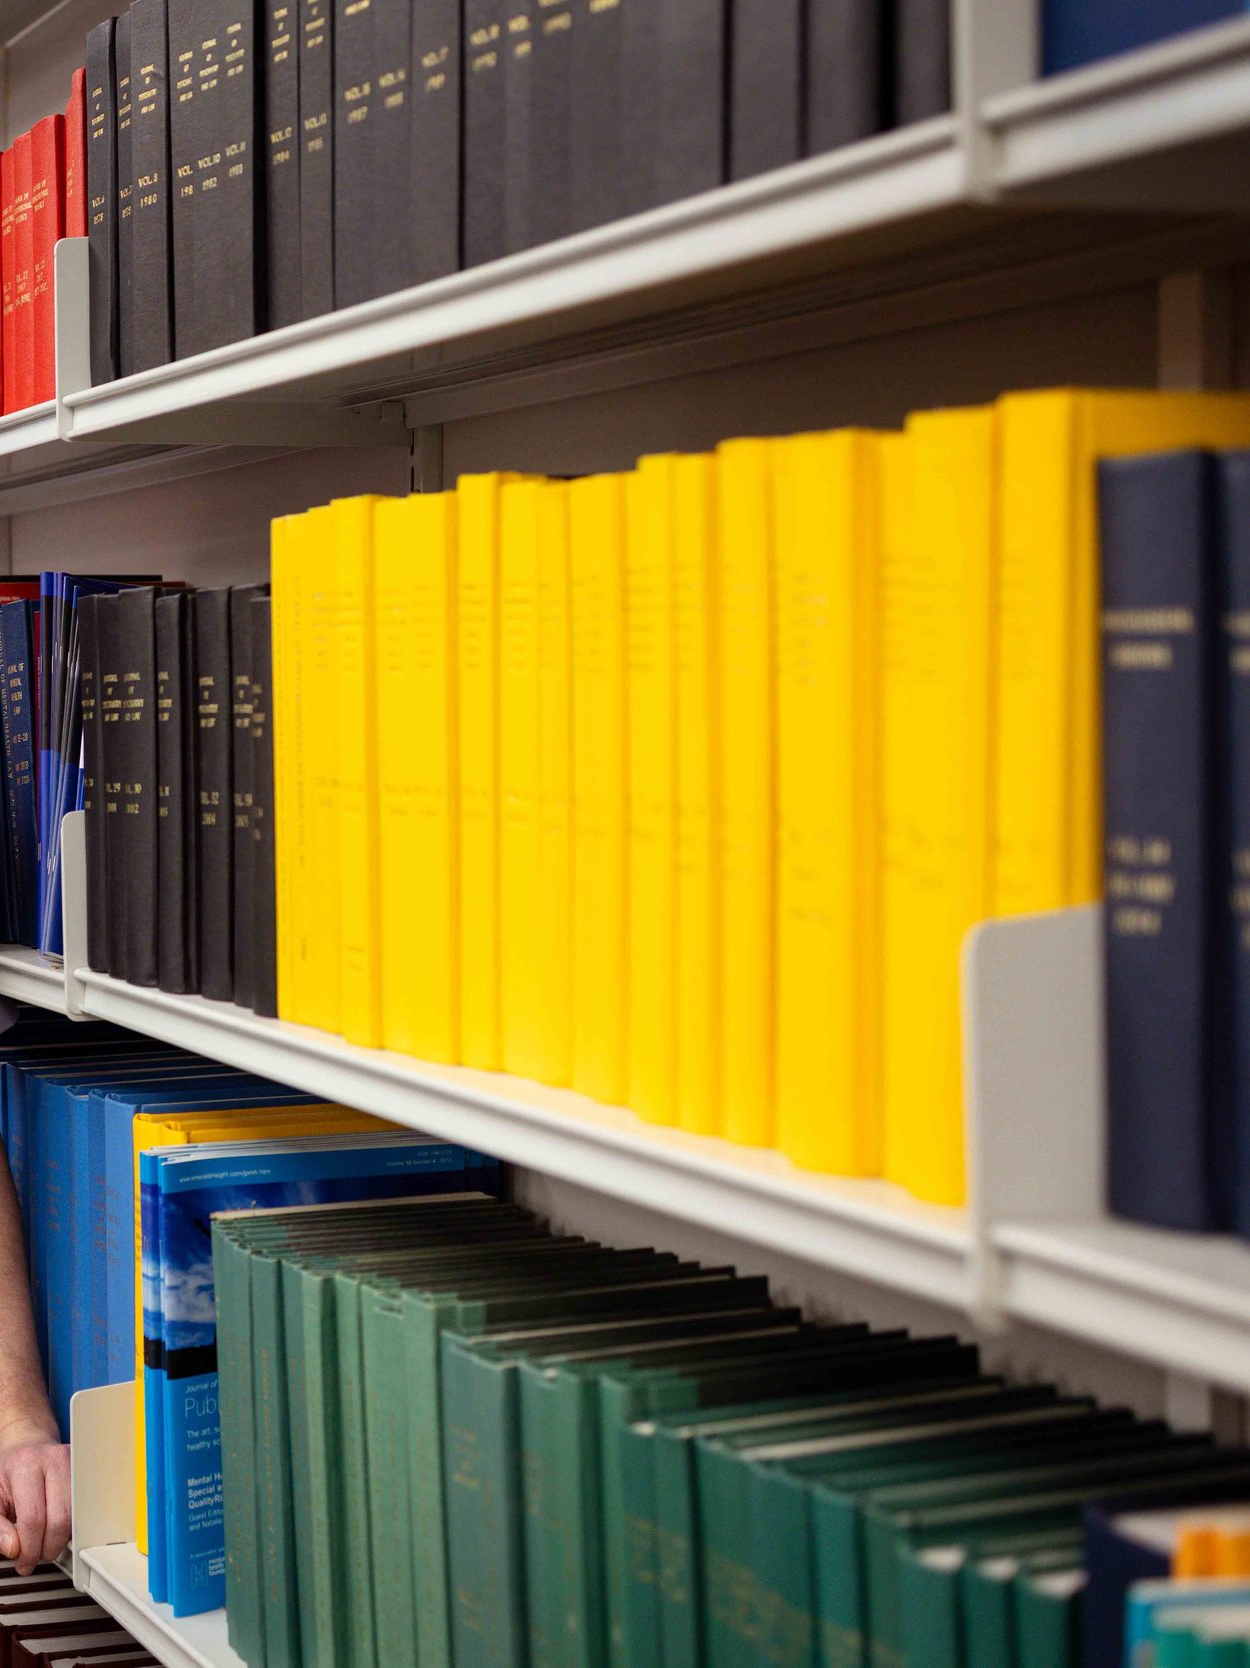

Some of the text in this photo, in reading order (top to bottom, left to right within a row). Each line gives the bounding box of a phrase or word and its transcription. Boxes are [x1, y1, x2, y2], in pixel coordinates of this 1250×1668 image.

[180, 184, 194, 198] 198
[140, 193, 158, 208] 1980
[185, 1380, 218, 1394] Journal of
[184, 1393, 217, 1418] Pub
[187, 1429, 200, 1439] The
[188, 1474, 213, 1488] Mental
[189, 1484, 215, 1499] Special
[189, 1494, 223, 1509] QualityRi
